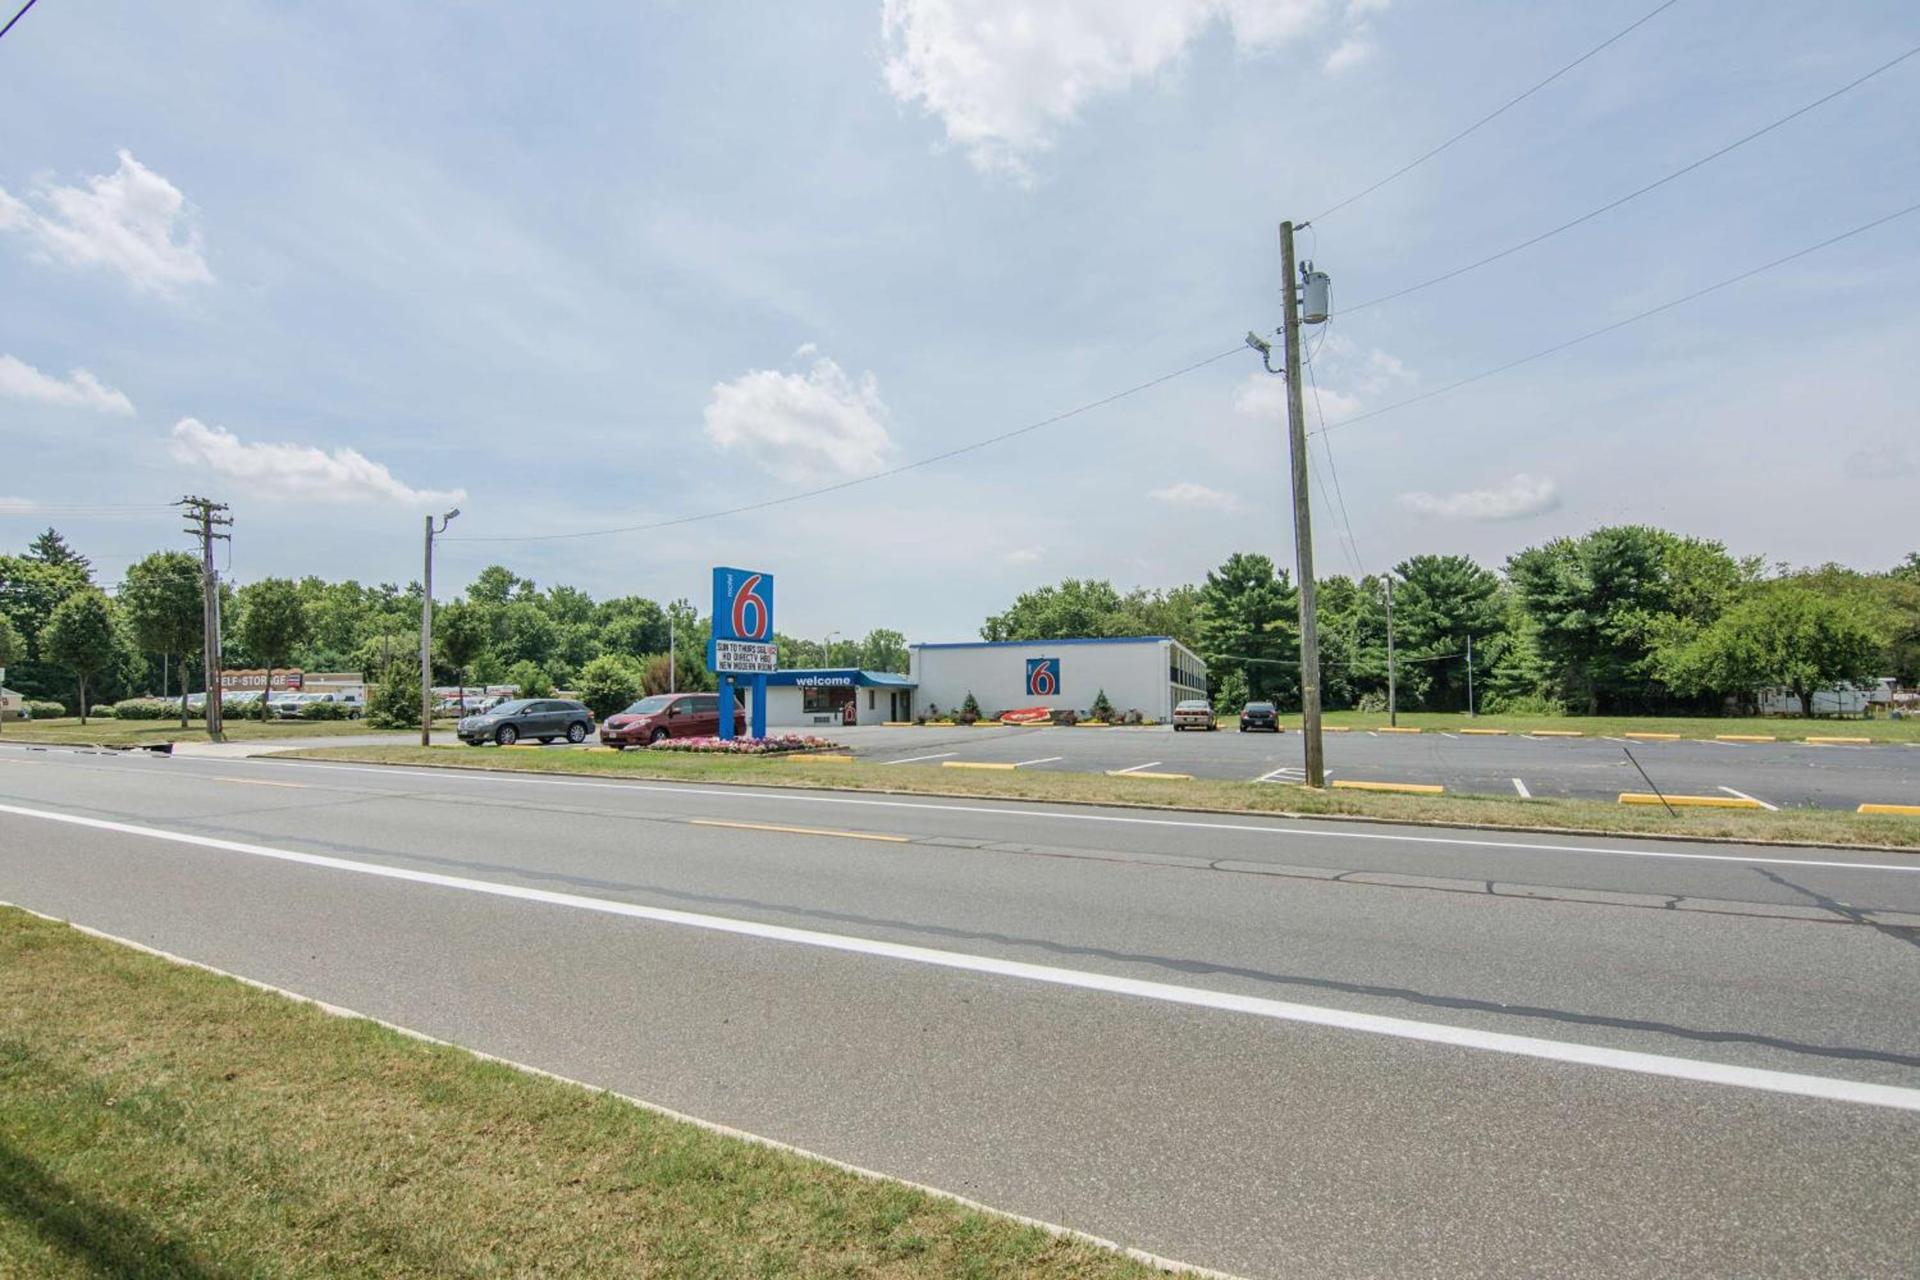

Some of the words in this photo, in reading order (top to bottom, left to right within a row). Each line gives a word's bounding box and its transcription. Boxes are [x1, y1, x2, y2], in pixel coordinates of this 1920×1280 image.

[732, 575, 768, 640] 6
[796, 675, 850, 686] welcome
[1030, 660, 1055, 695] 6
[844, 700, 856, 722] 6
